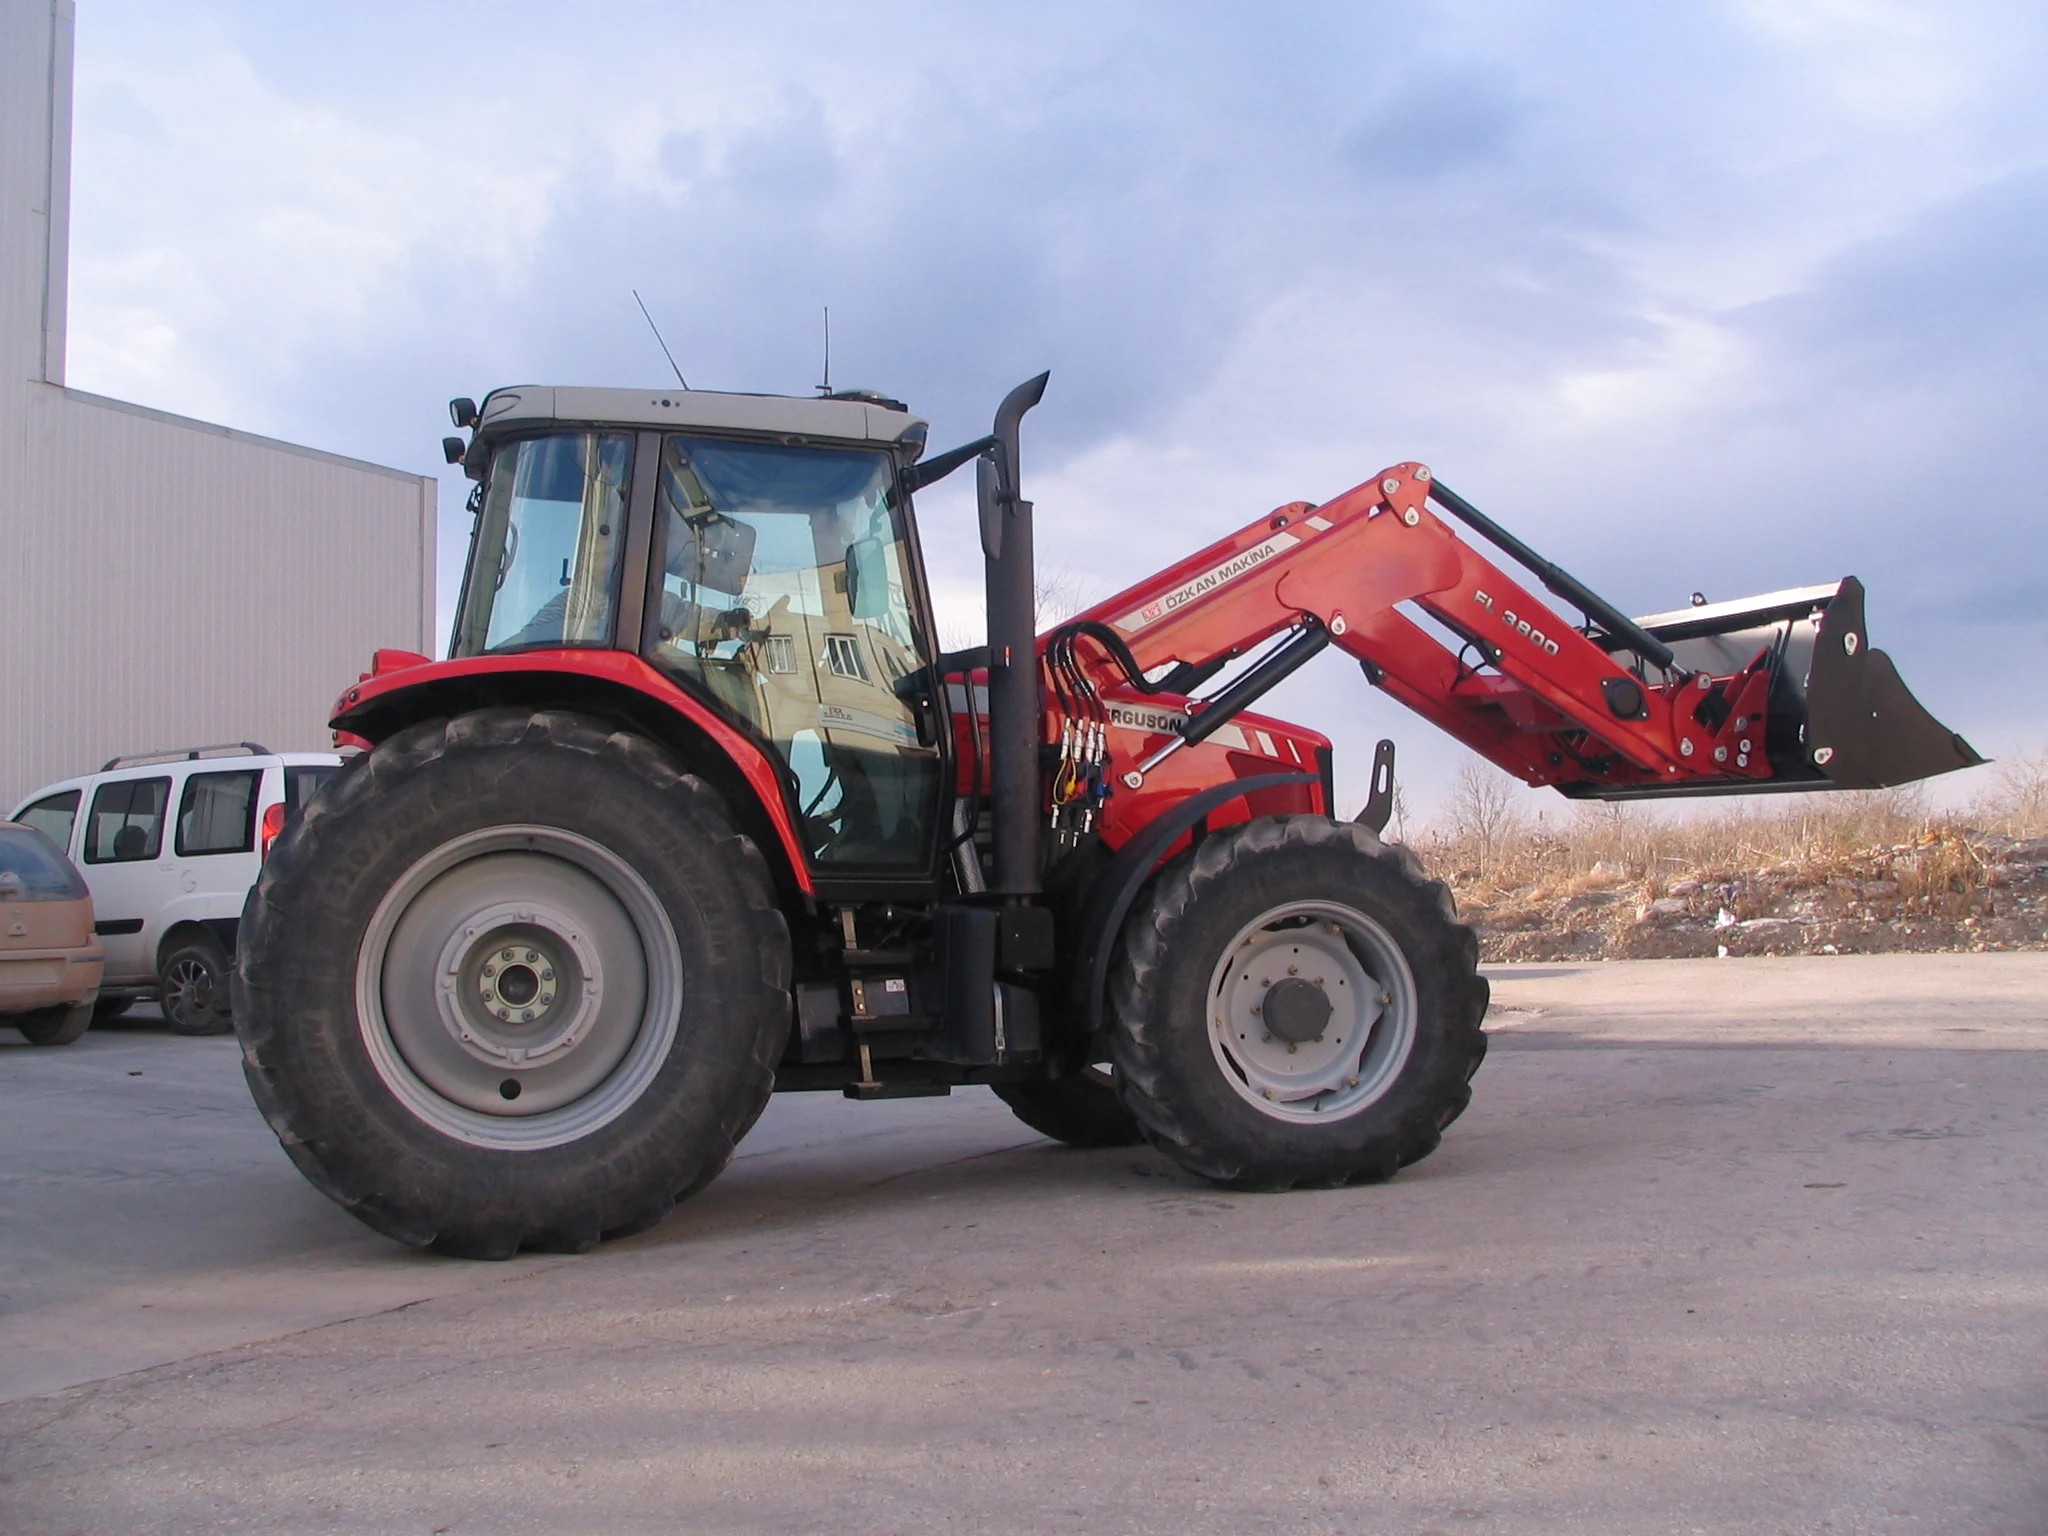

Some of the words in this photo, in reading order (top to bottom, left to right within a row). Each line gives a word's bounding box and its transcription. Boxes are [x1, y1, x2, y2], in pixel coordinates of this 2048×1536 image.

[1165, 575, 1217, 610] ÖZKAN
[1218, 545, 1276, 581] MAKİNA
[1474, 590, 1496, 614] FL
[1502, 610, 1559, 655] 3800
[1108, 709, 1182, 731] RGUSON
